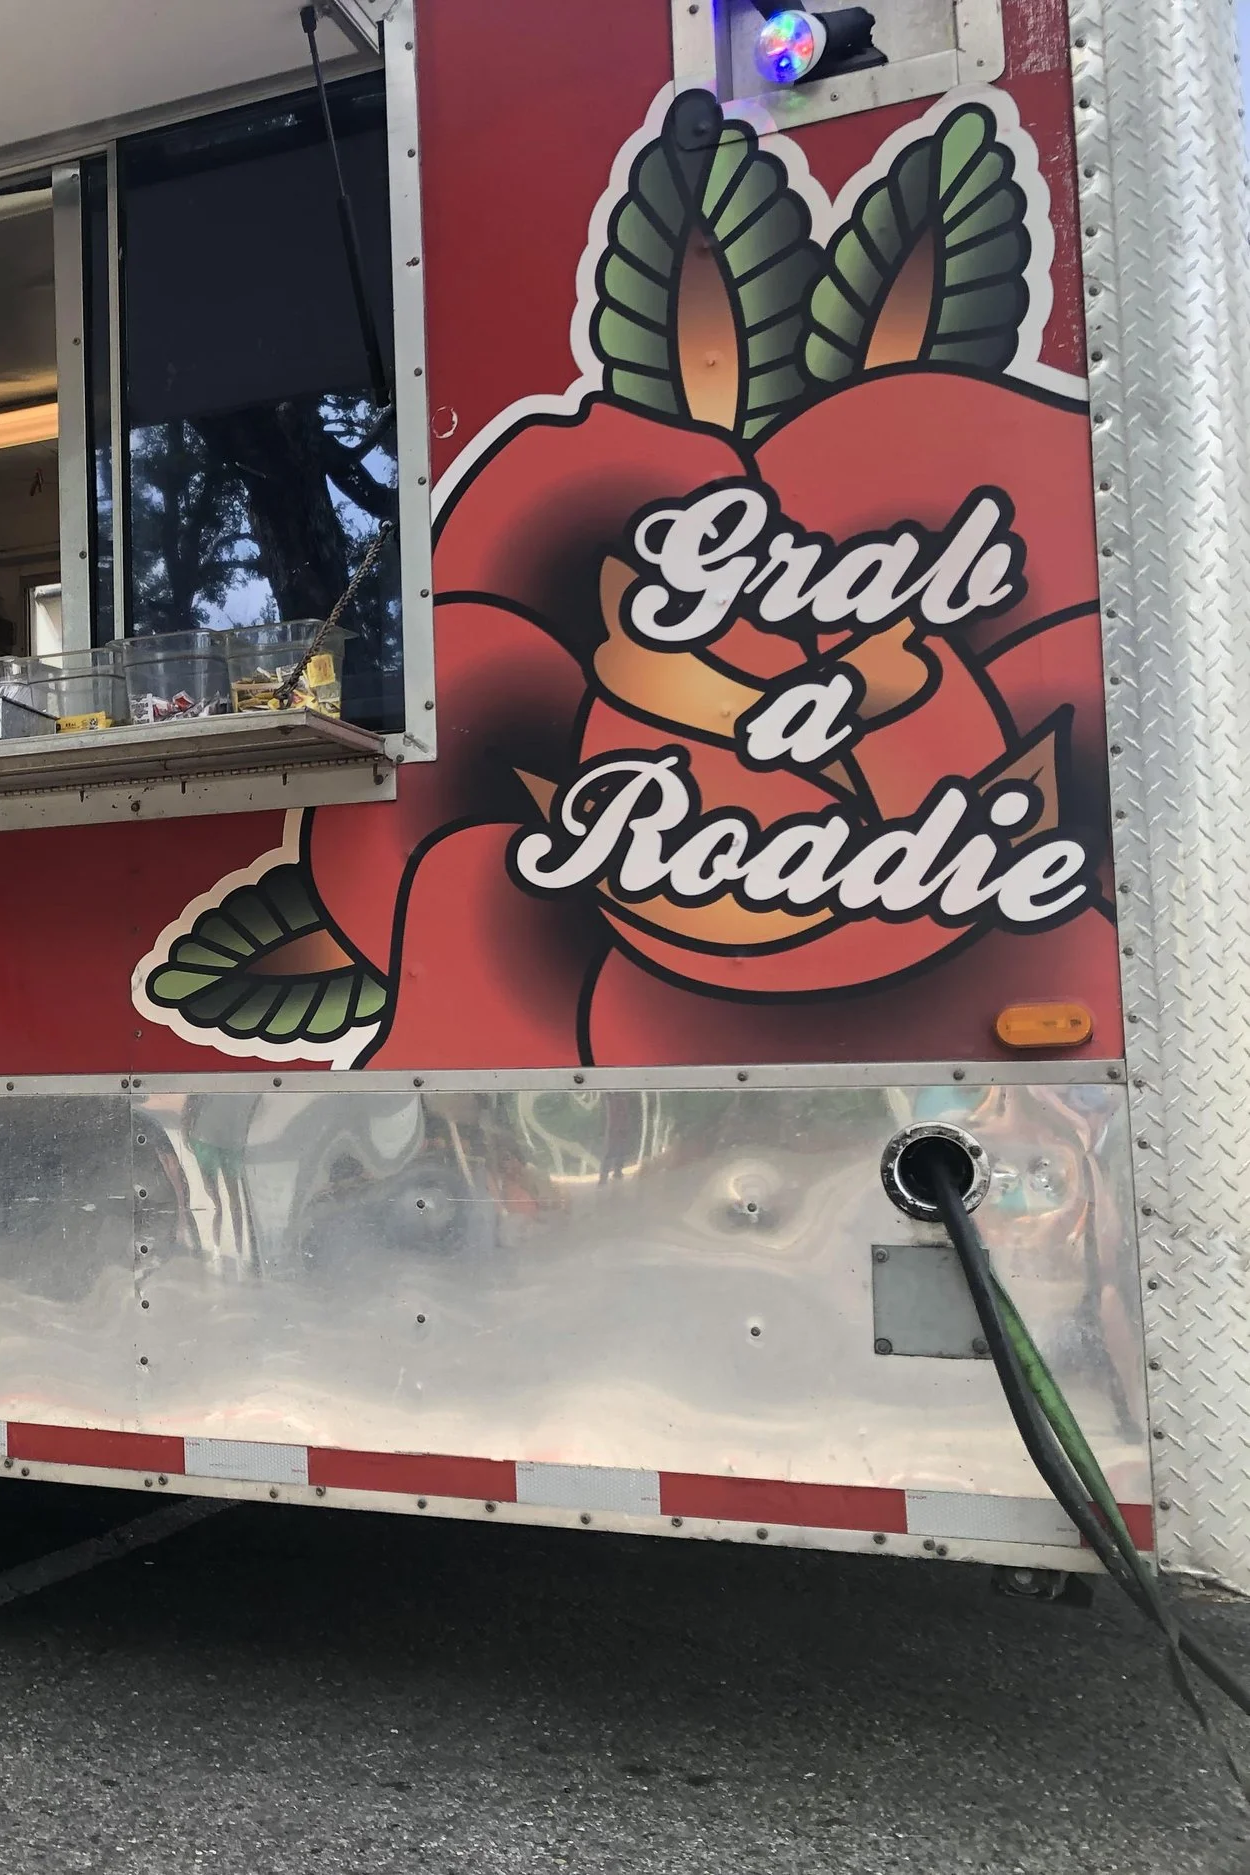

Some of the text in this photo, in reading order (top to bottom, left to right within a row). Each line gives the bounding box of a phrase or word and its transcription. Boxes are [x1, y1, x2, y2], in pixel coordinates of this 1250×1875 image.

[629, 487, 1014, 642] Grab
[746, 673, 854, 764] a
[516, 755, 1088, 923] Roadie
